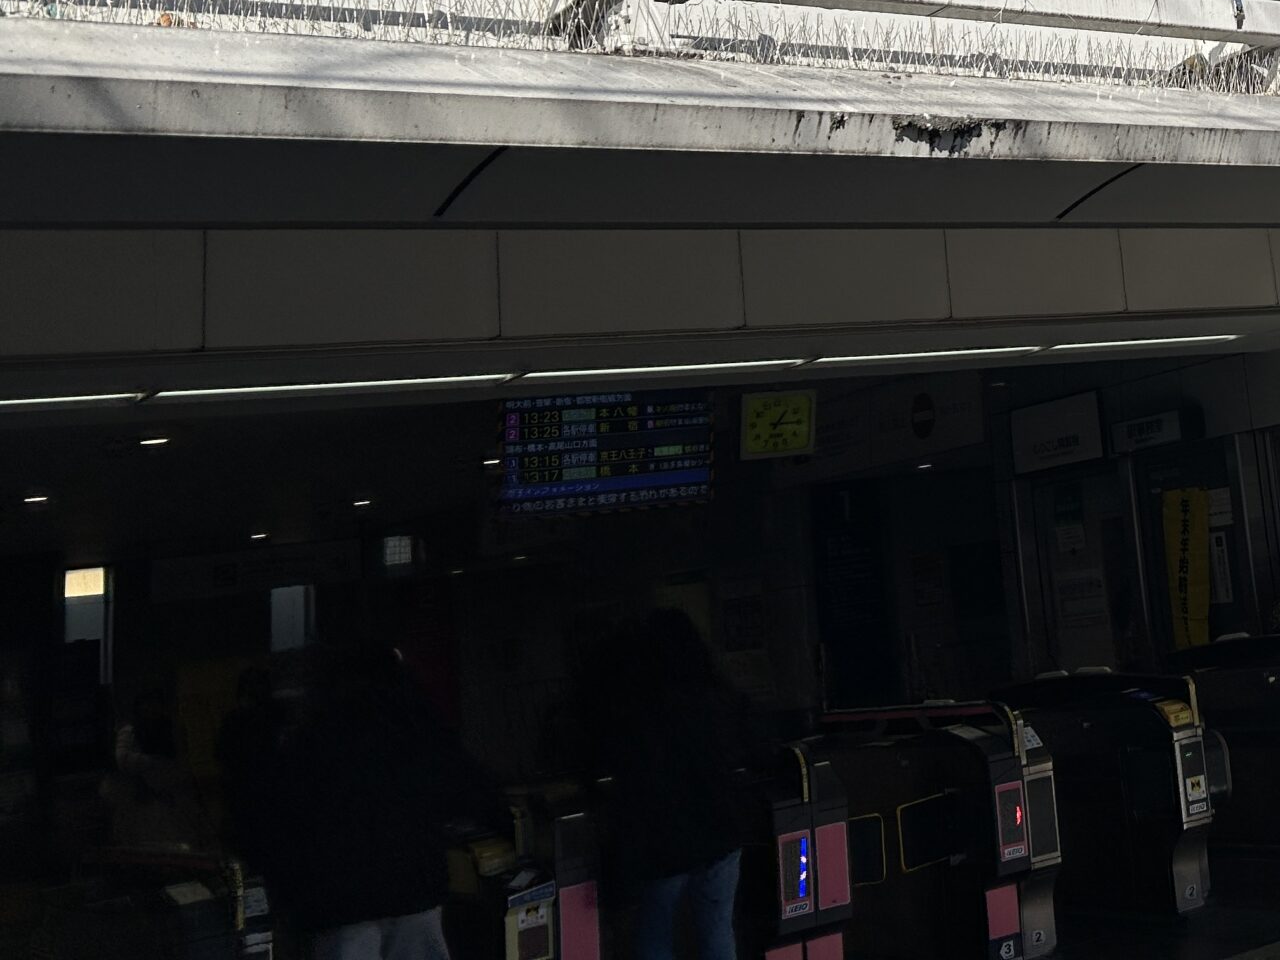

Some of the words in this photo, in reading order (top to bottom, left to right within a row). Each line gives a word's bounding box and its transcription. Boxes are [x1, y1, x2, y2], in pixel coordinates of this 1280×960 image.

[523, 410, 561, 426] 13:23
[523, 425, 561, 441] 13:25
[523, 454, 561, 469] 13:15
